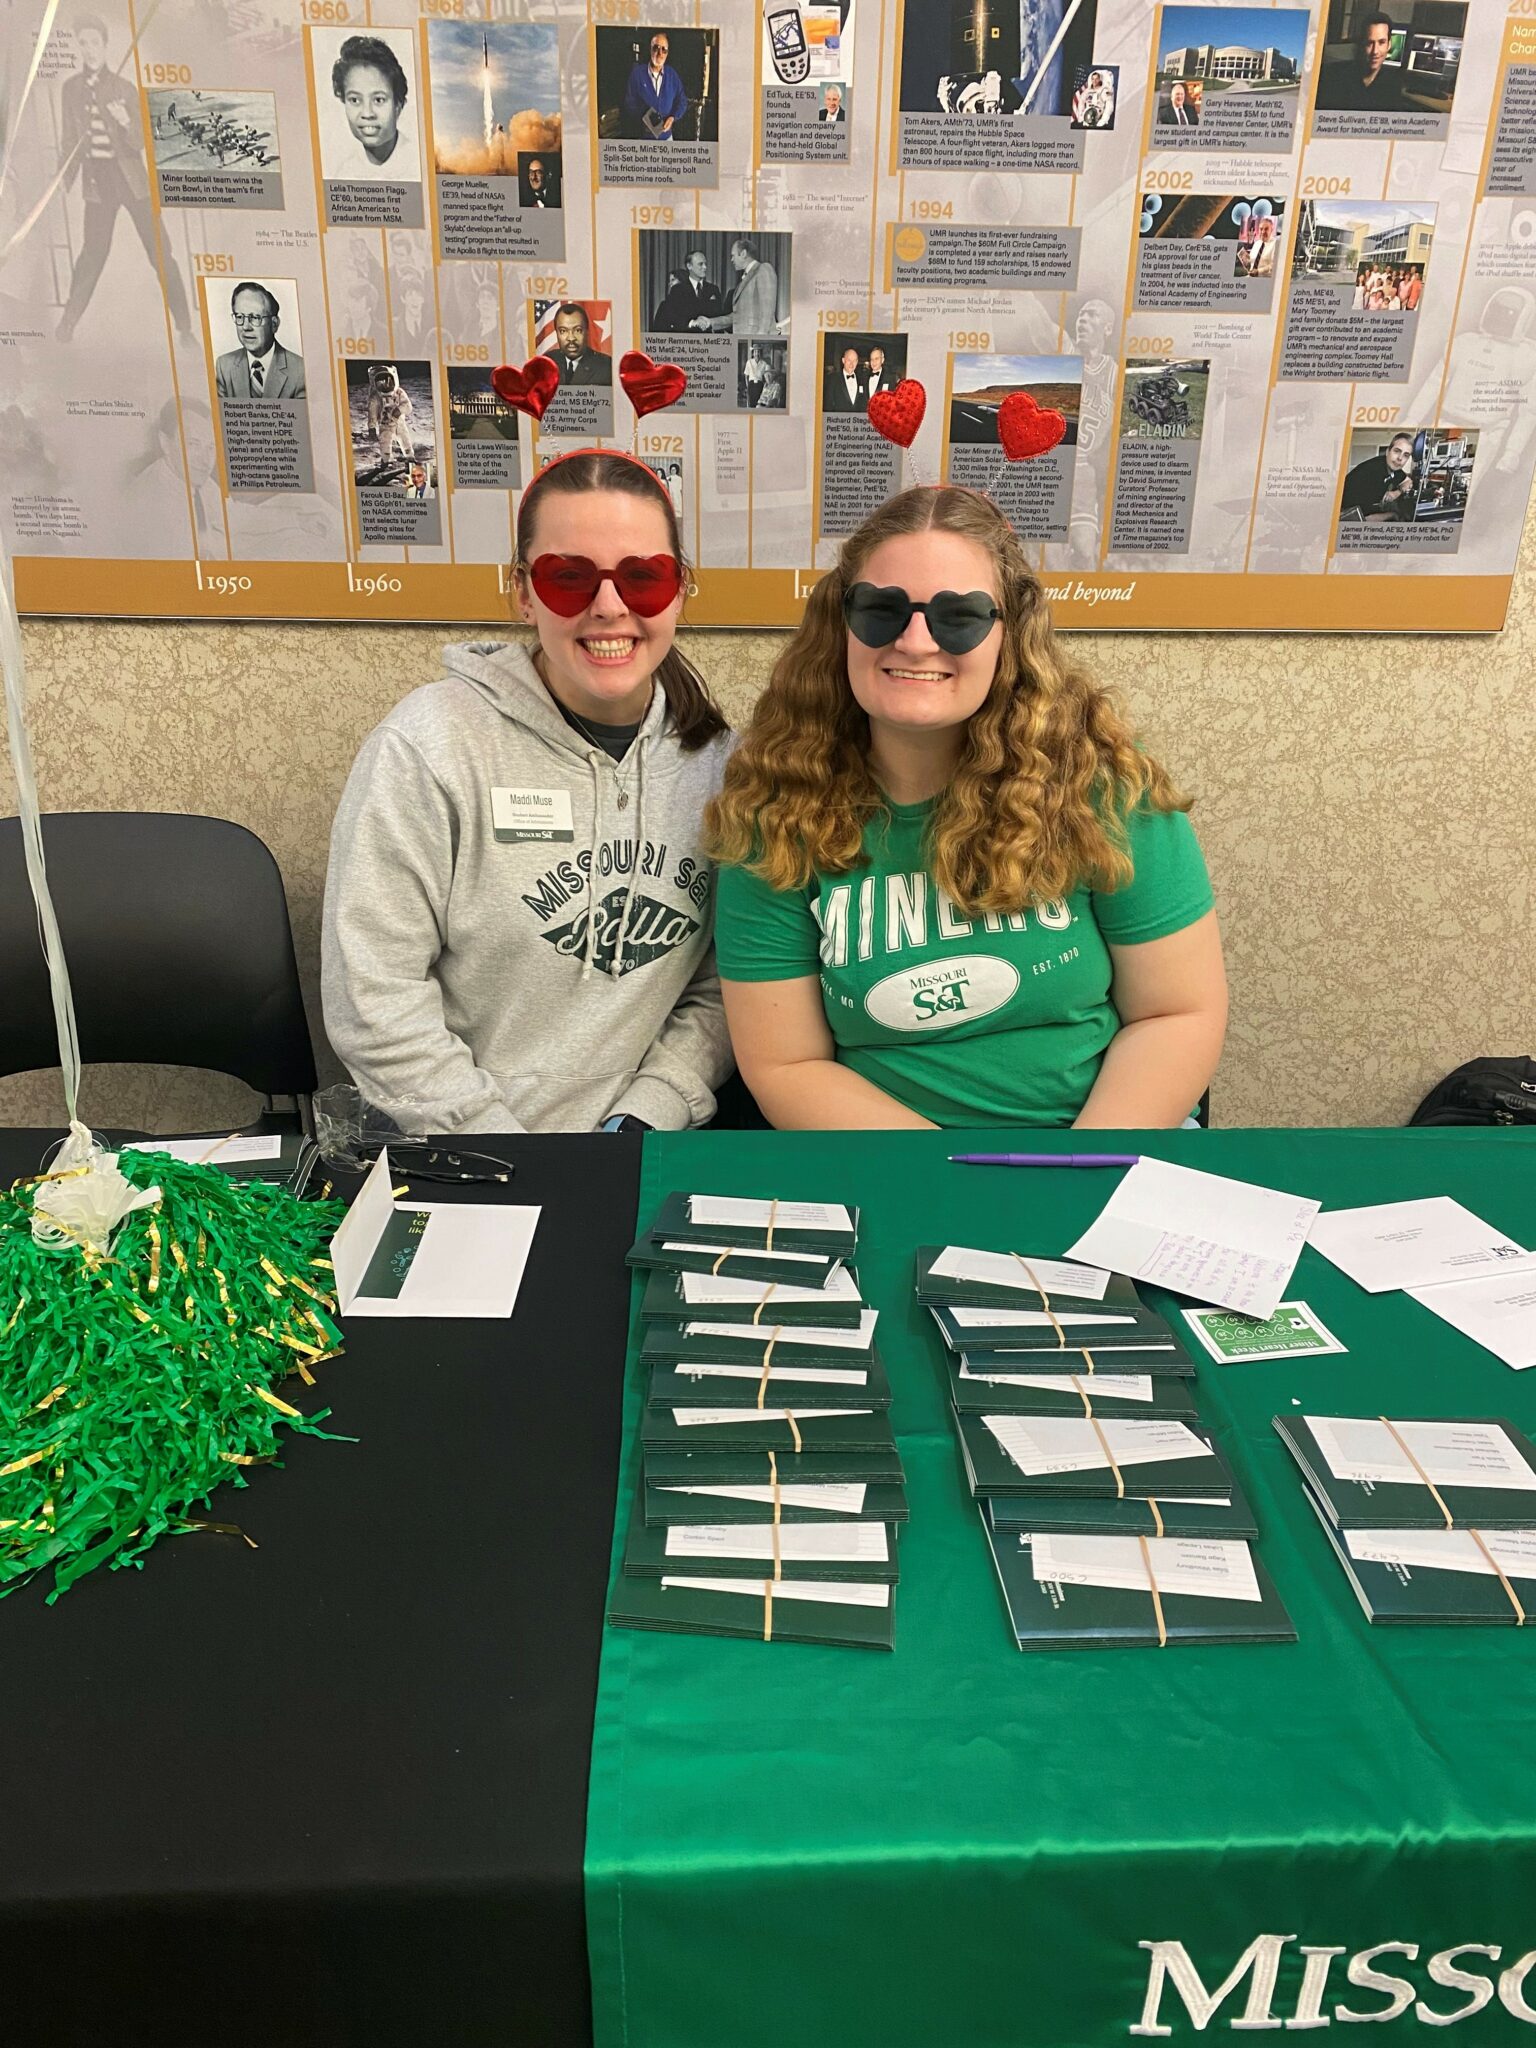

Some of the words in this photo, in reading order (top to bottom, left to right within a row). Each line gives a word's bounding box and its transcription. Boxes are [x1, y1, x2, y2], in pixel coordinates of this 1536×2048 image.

[302, 3, 349, 20] 1960
[144, 64, 191, 83] 1950
[778, 91, 793, 99] Tuck,
[767, 101, 790, 109] founds
[767, 111, 797, 120] personal
[766, 121, 802, 131] navigation
[804, 124, 836, 132] company
[921, 118, 942, 127] Akers,
[977, 119, 998, 127] UMR's
[1339, 117, 1367, 125] Sullivan,
[1409, 118, 1440, 127] Academy
[766, 131, 798, 141] Magellan
[815, 132, 845, 141] develops
[904, 128, 938, 136] astronaut,
[940, 128, 964, 138] repairs
[978, 129, 1002, 137] Hubble
[1004, 130, 1025, 139] Space
[618, 145, 638, 154] Scott,
[672, 146, 696, 154] invents
[604, 155, 633, 164] Split-Set
[635, 155, 648, 163] bolt
[662, 156, 691, 166] Ingersoll
[766, 151, 804, 161] Positioning
[806, 152, 831, 161] System
[833, 152, 848, 160] unit.
[621, 165, 681, 175] friction-stabilizing
[683, 166, 696, 174] bolt
[185, 175, 212, 183] football
[213, 176, 231, 184] team
[233, 176, 249, 184] wins
[1145, 171, 1193, 189] 2002
[182, 185, 202, 194] Bowl,
[225, 186, 248, 194] team's
[330, 185, 346, 193] Lelia
[348, 186, 384, 195] Thompson
[386, 186, 407, 196] Flagg,
[1303, 176, 1351, 195] 2004
[165, 194, 207, 204] post-season
[209, 195, 236, 203] contest.
[354, 195, 385, 203] becomes
[332, 204, 356, 212] African
[358, 205, 391, 213] American
[910, 201, 953, 219] 1994
[333, 214, 363, 224] graduate
[630, 206, 674, 224] 1979
[194, 254, 234, 272] 1951
[1159, 254, 1187, 262] approval
[526, 277, 568, 295] 1972
[817, 311, 860, 327] 1992
[336, 337, 376, 354] 1961
[948, 332, 990, 349] 1999
[1128, 337, 1174, 354] 2002
[447, 344, 489, 361] 1968
[1355, 407, 1400, 423] 2007
[552, 424, 587, 433] Engineers.
[1139, 423, 1186, 438] ELADIN
[643, 436, 683, 452] 1972
[1123, 443, 1148, 451] ELADIN,
[1156, 444, 1171, 453] high-
[457, 452, 480, 460] Library
[459, 477, 499, 486] Gymnasium.
[1364, 526, 1384, 534] Friend,
[207, 575, 252, 595] 1950
[355, 574, 402, 597] 1960
[1073, 582, 1136, 607] beyond
[510, 794, 532, 805] Maddi
[533, 795, 553, 806] Muse
[556, 904, 692, 959] Rolla
[605, 959, 636, 971] 170
[1032, 963, 1055, 976] EST.
[1059, 947, 1079, 964] 1870
[910, 967, 968, 990] MISSOURI
[912, 979, 971, 1021] S&T
[1231, 1345, 1259, 1355] Week
[1260, 1343, 1287, 1352] Heart
[1289, 1340, 1319, 1350] Miner
